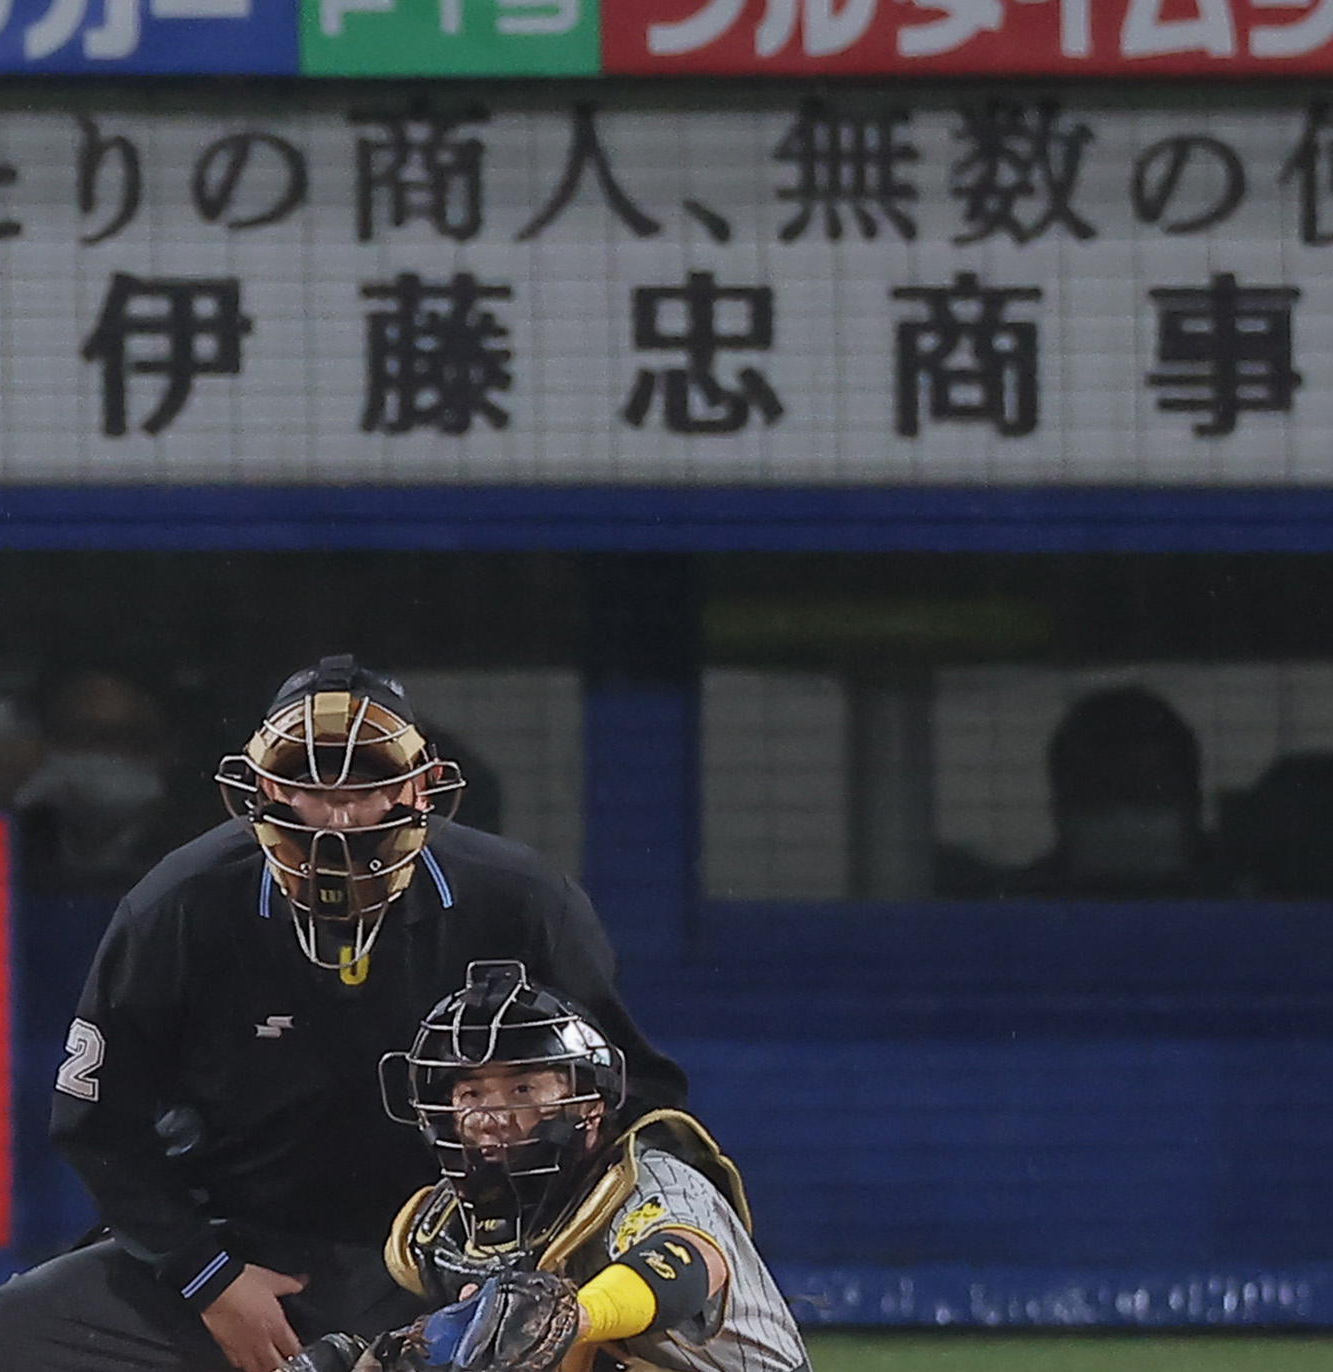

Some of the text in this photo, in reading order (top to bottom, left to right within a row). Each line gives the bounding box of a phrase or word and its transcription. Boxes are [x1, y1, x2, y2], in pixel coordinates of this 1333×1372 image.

[81, 270, 1303, 437] 伊藤忠商事
[55, 1017, 106, 1102] 2
